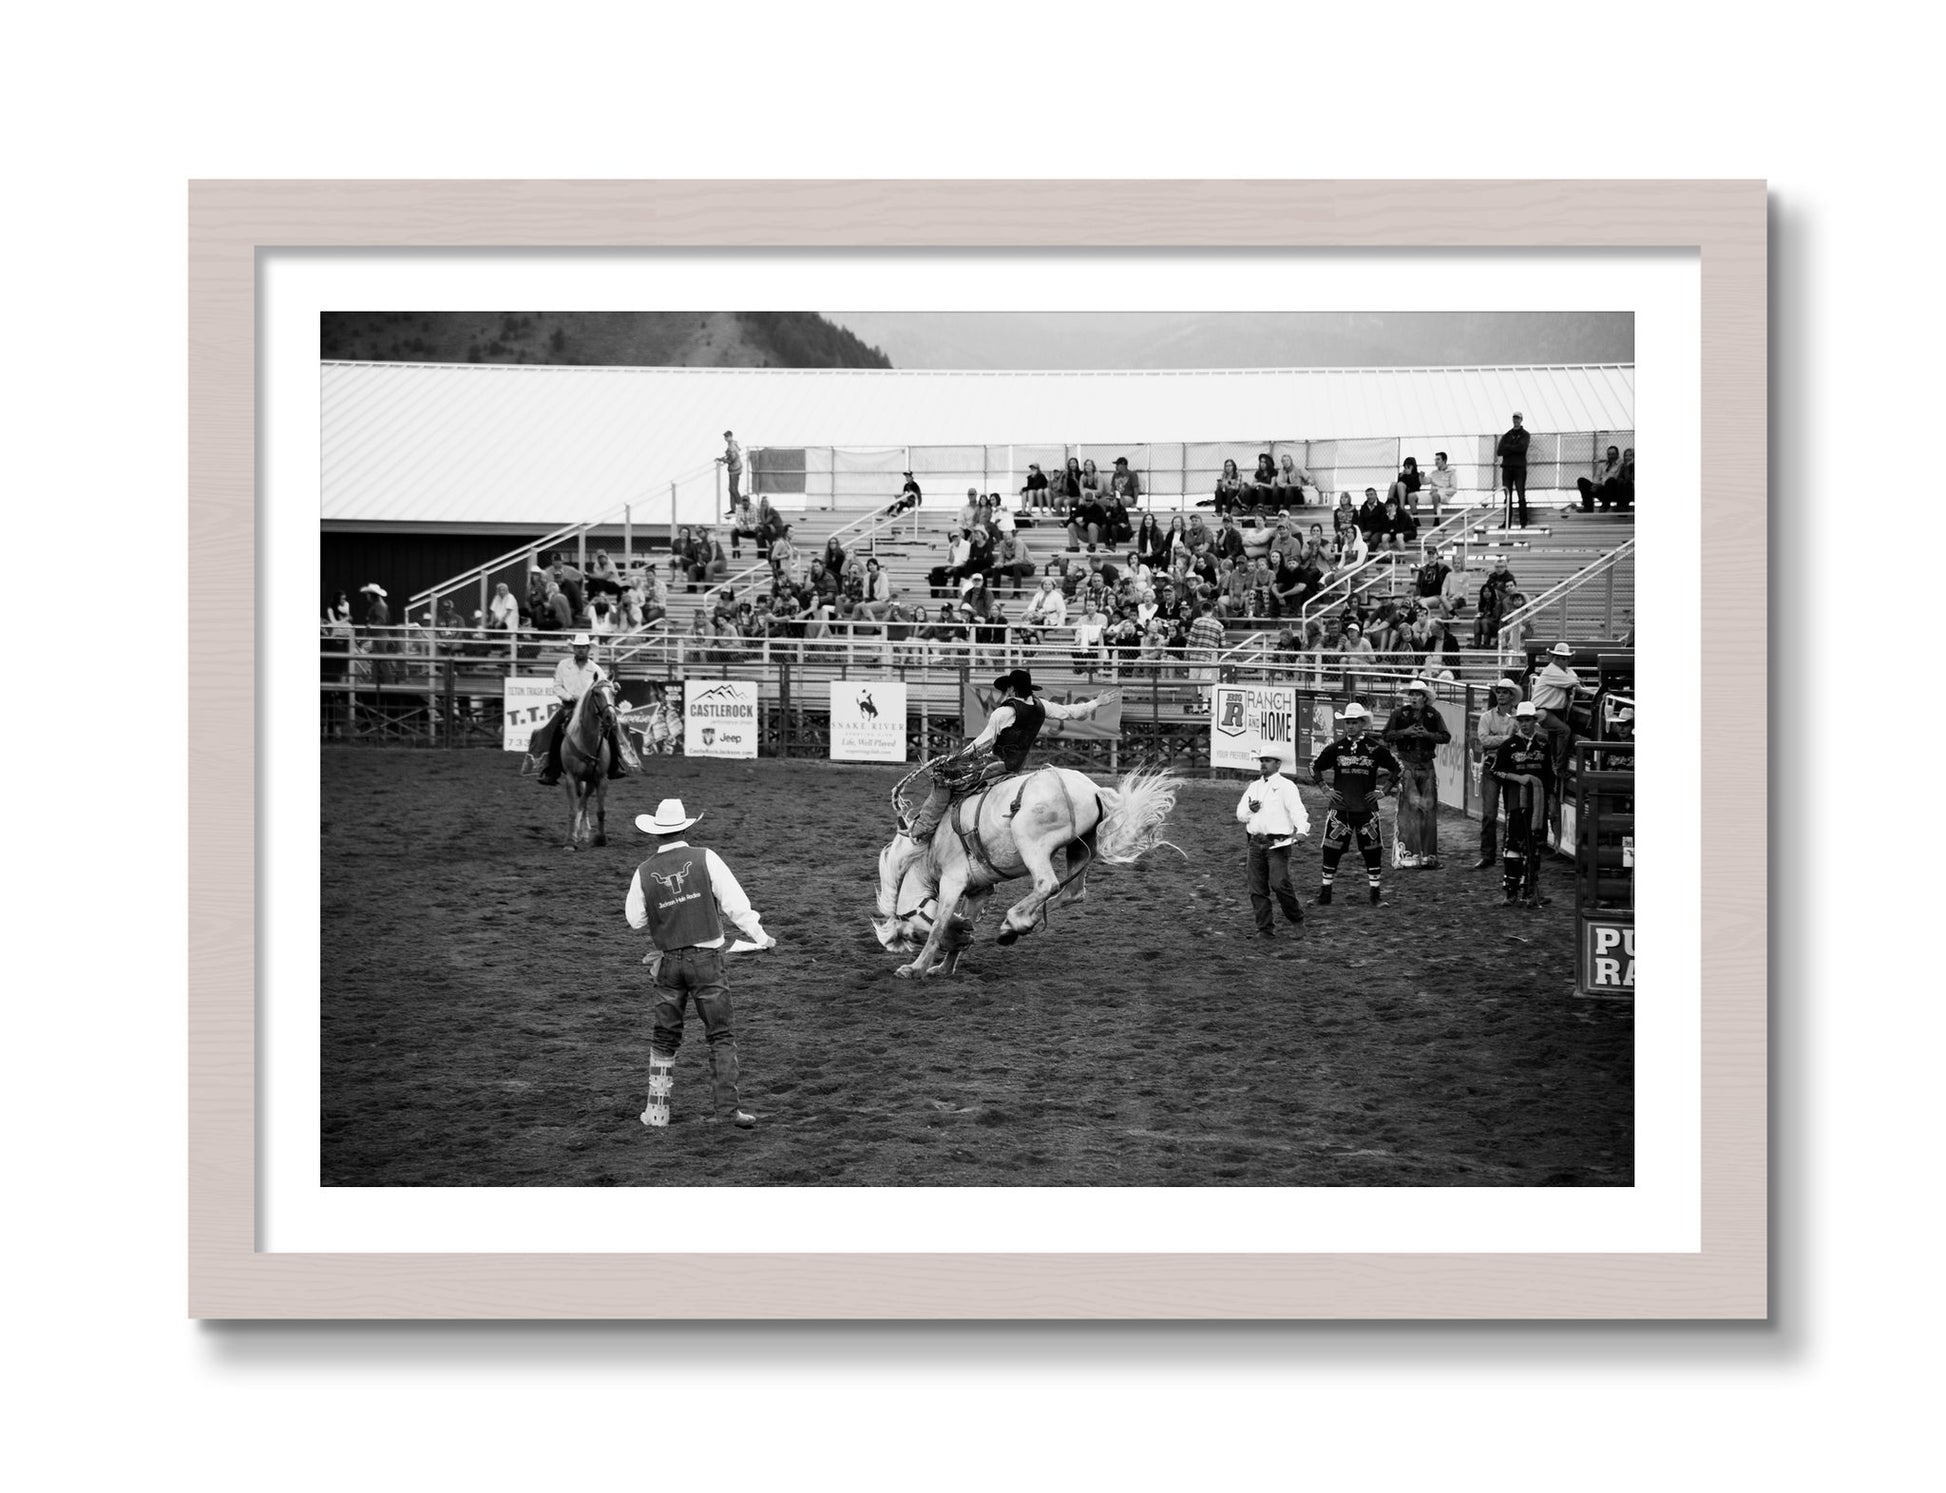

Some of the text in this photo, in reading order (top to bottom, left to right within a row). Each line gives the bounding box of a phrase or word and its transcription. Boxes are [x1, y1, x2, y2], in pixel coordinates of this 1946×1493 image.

[1247, 690, 1292, 711] RANCH
[690, 704, 753, 718] CASTLEROCK
[1221, 702, 1244, 728] R
[831, 722, 904, 731] SNAKE RIVER
[1261, 711, 1292, 742] HOME
[720, 733, 742, 744] Jeep
